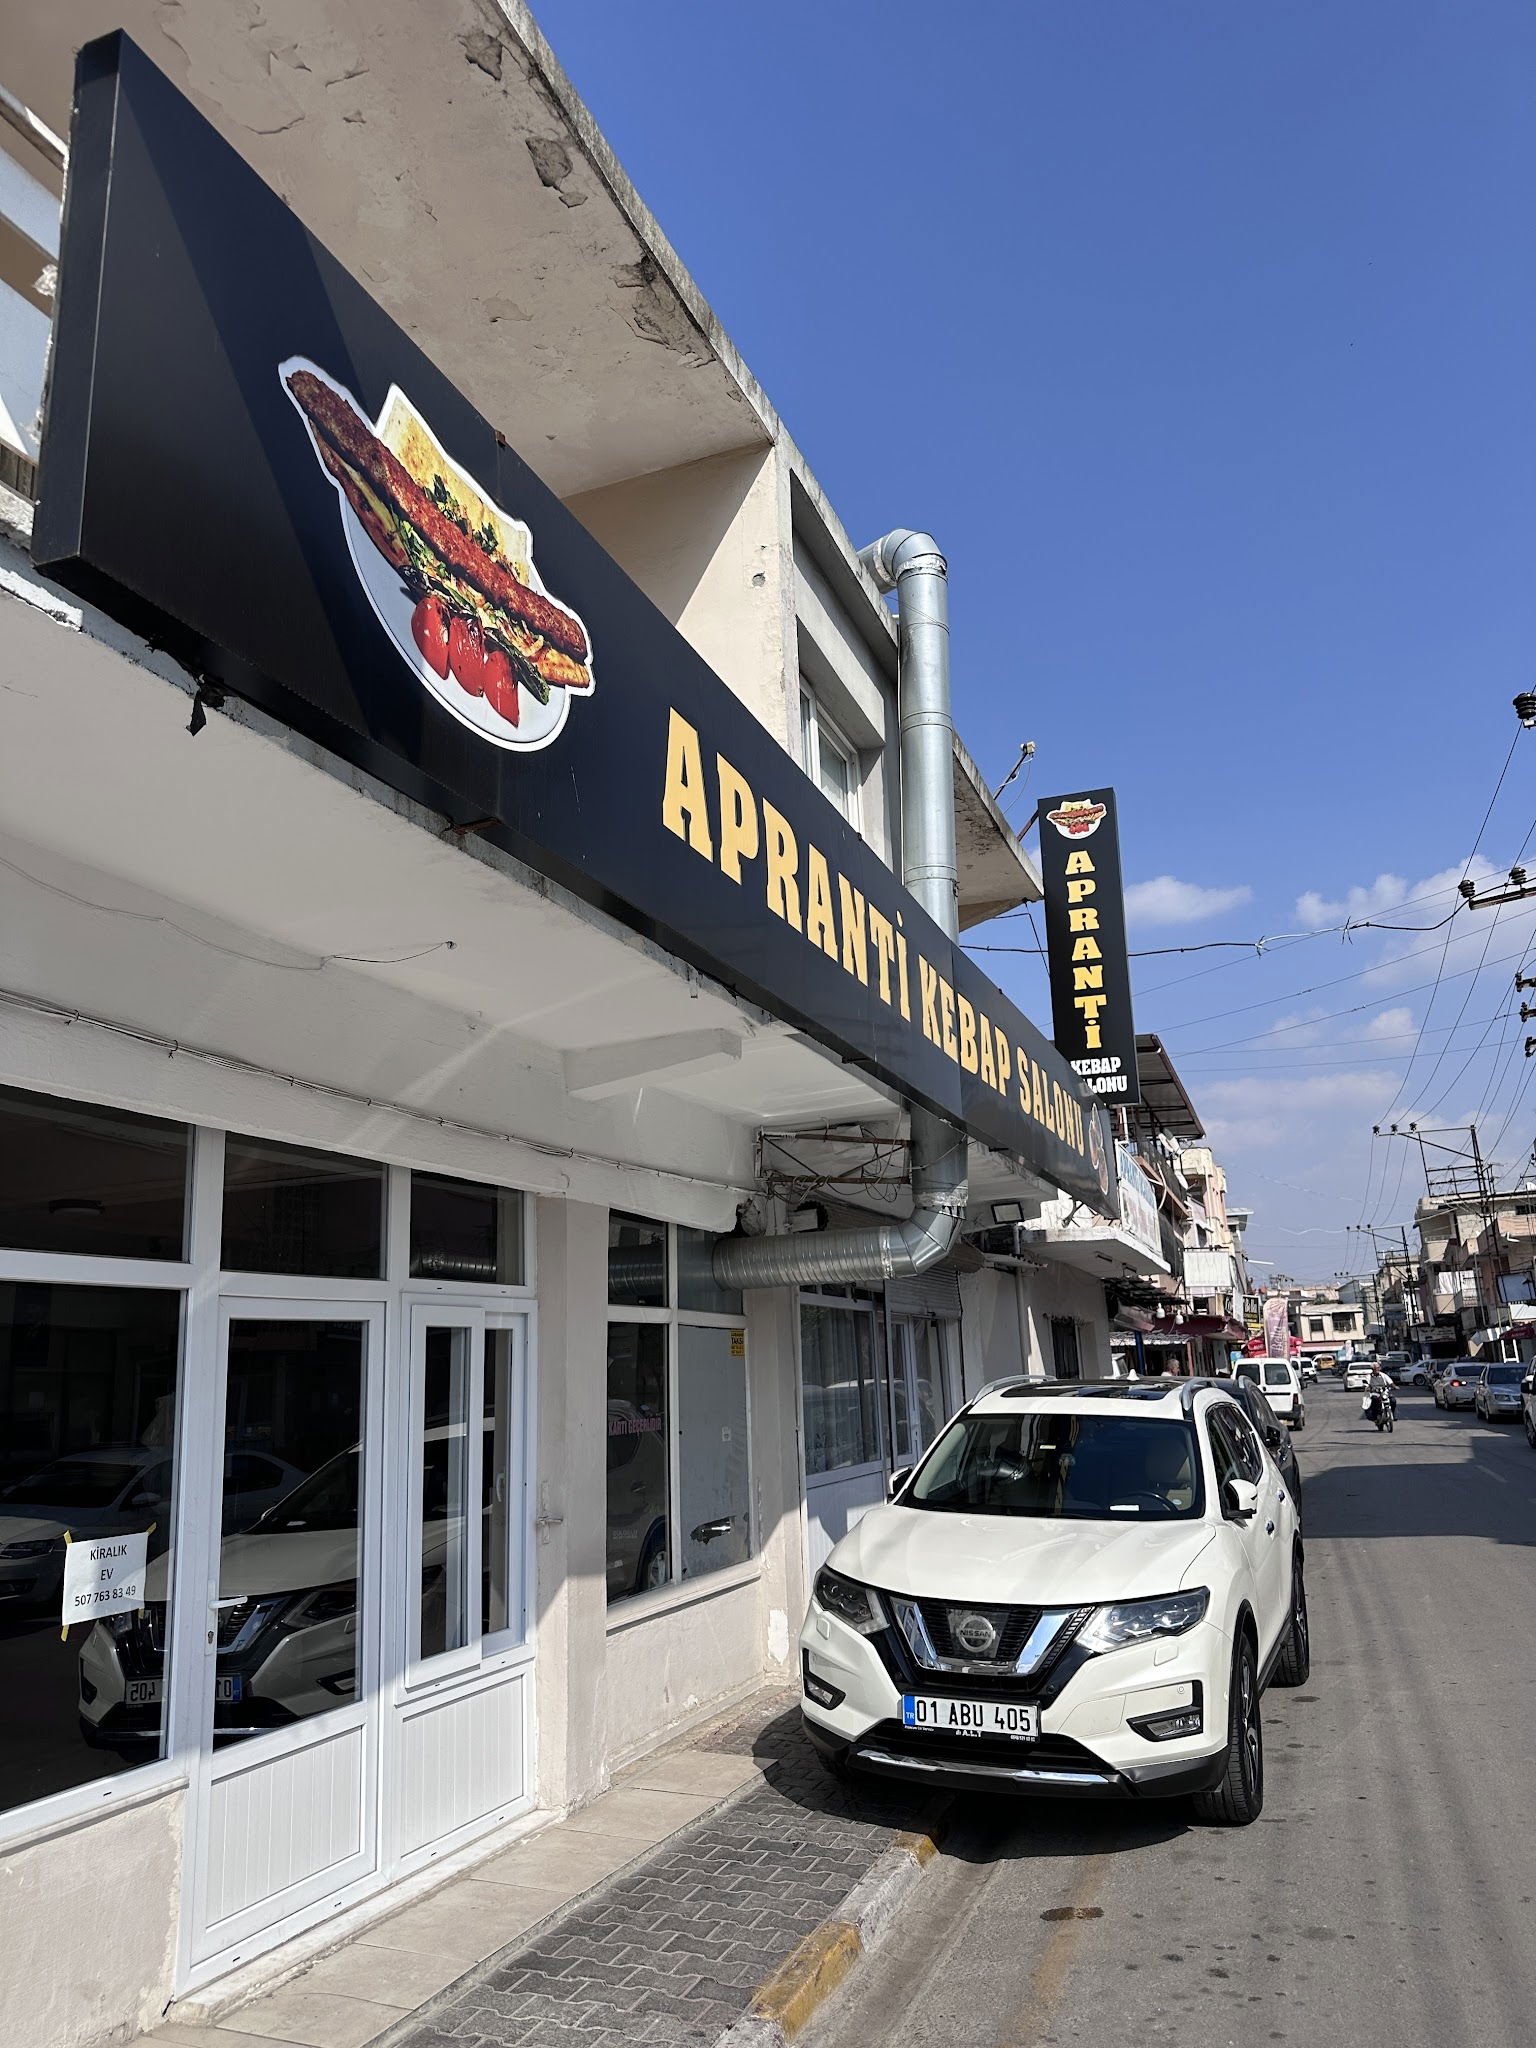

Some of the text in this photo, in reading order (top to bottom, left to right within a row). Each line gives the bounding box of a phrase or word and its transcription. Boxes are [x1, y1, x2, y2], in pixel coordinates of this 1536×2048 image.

[662, 706, 1085, 1157] APRANTİ KEBAP SALONU
[90, 1544, 127, 1560] KİRALIK
[100, 1568, 114, 1580] EV
[74, 1585, 136, 1606] 507 763 83 49
[959, 1629, 992, 1638] NISSAN
[906, 1700, 1031, 1732] TR 01 ABU 405
